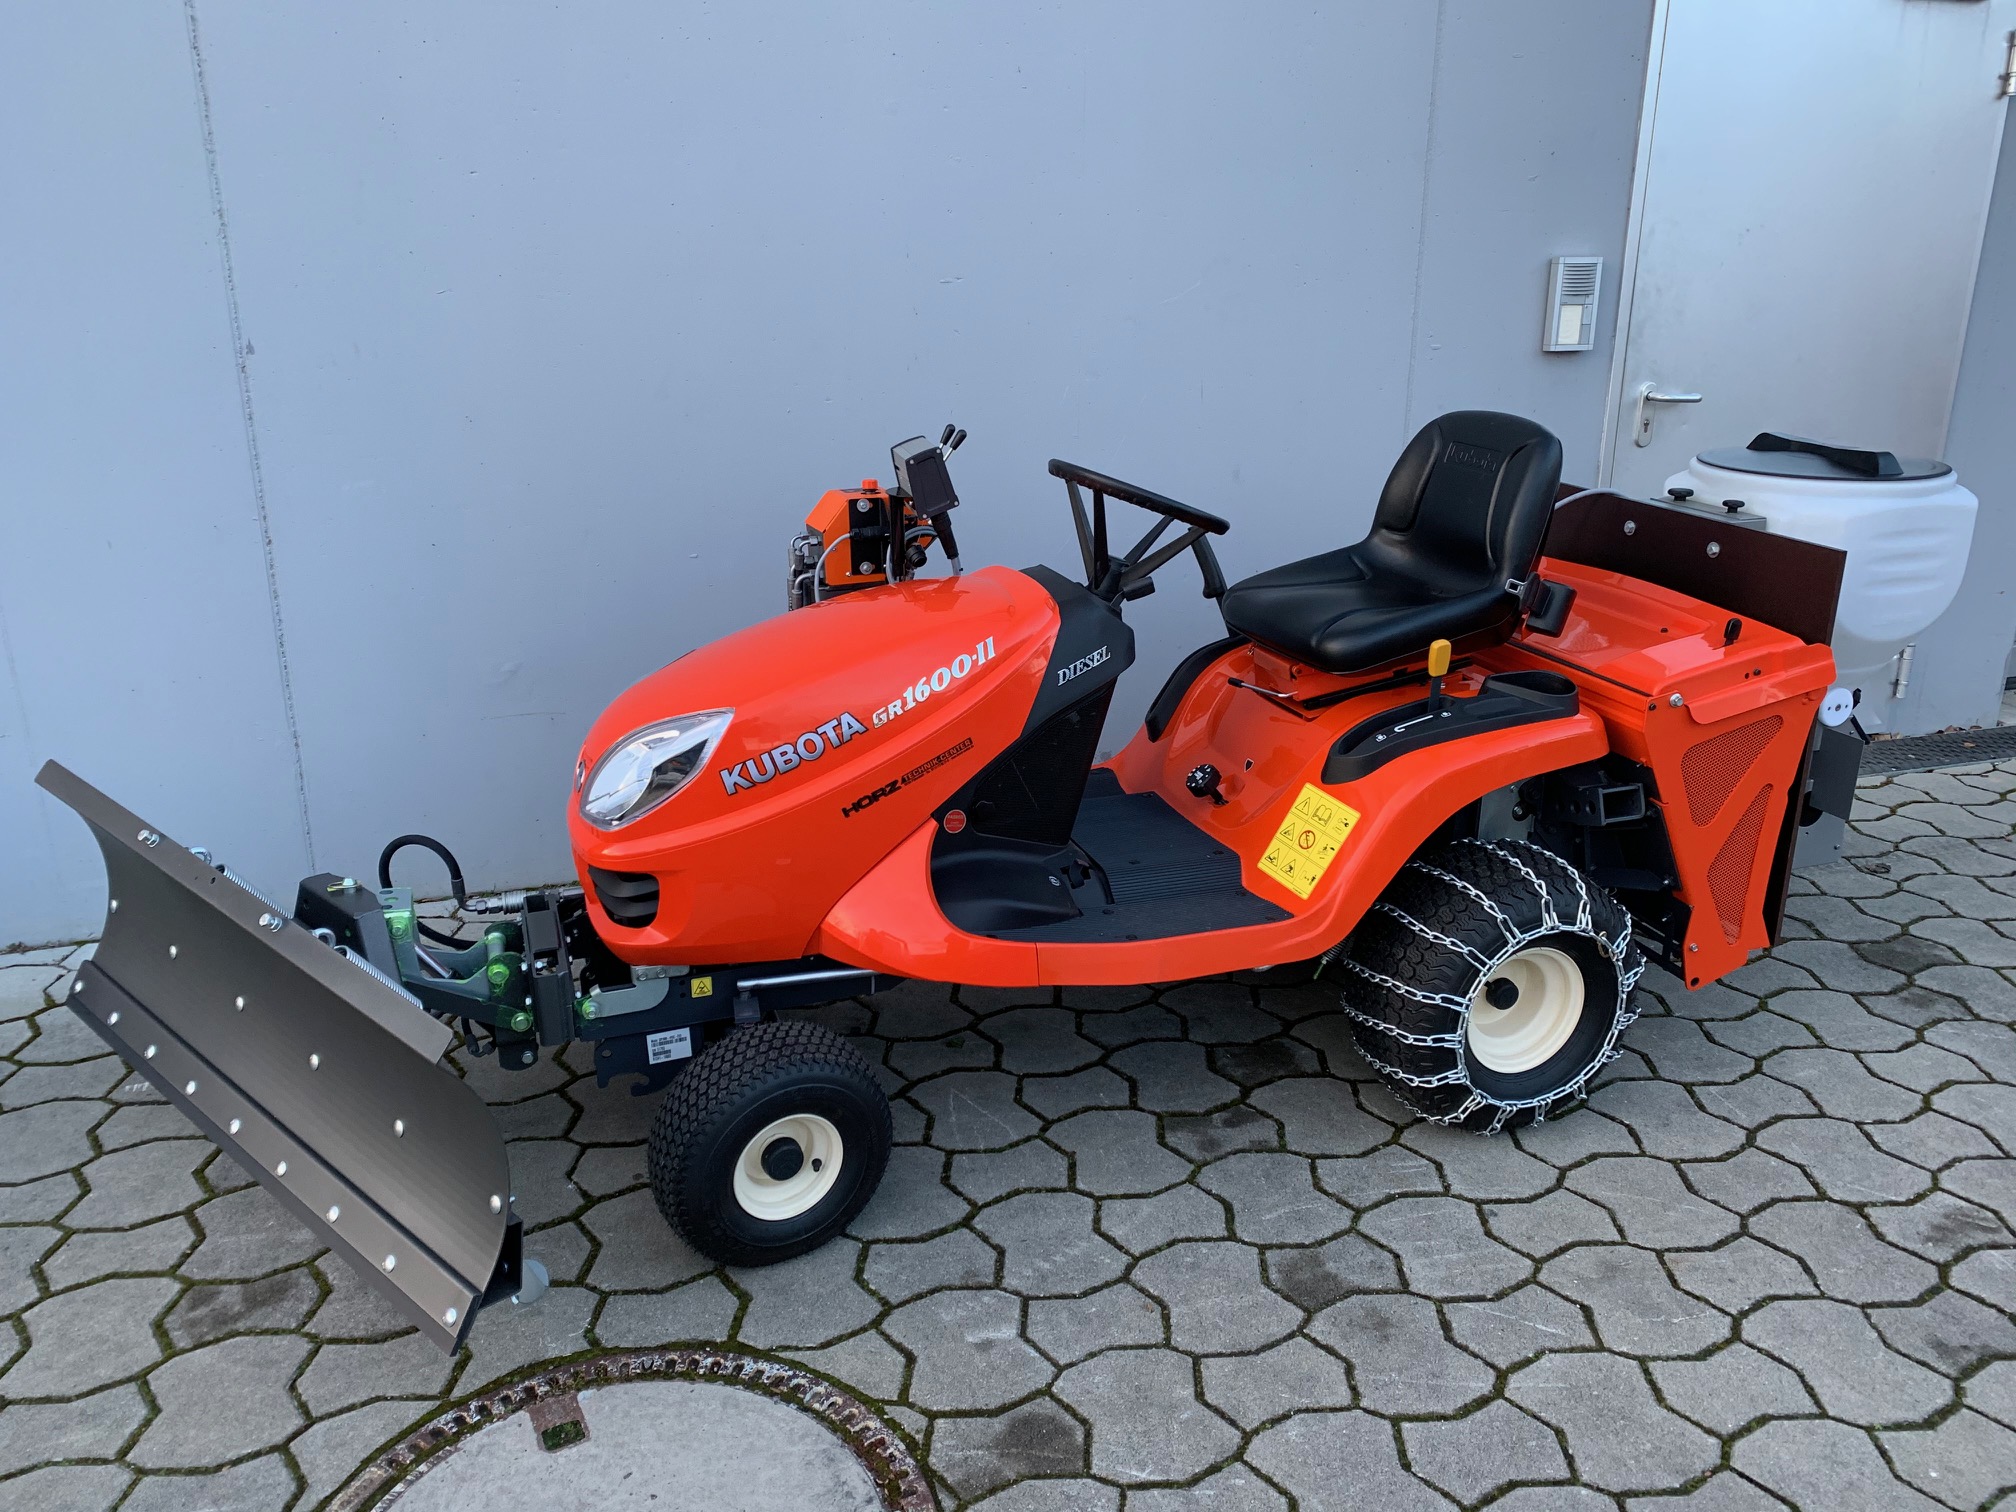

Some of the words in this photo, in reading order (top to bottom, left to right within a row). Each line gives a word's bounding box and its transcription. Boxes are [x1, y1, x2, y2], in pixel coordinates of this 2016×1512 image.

[1057, 645, 1111, 686] DIESEL
[719, 711, 869, 796] KUBOTA
[842, 780, 902, 818] HORZ
